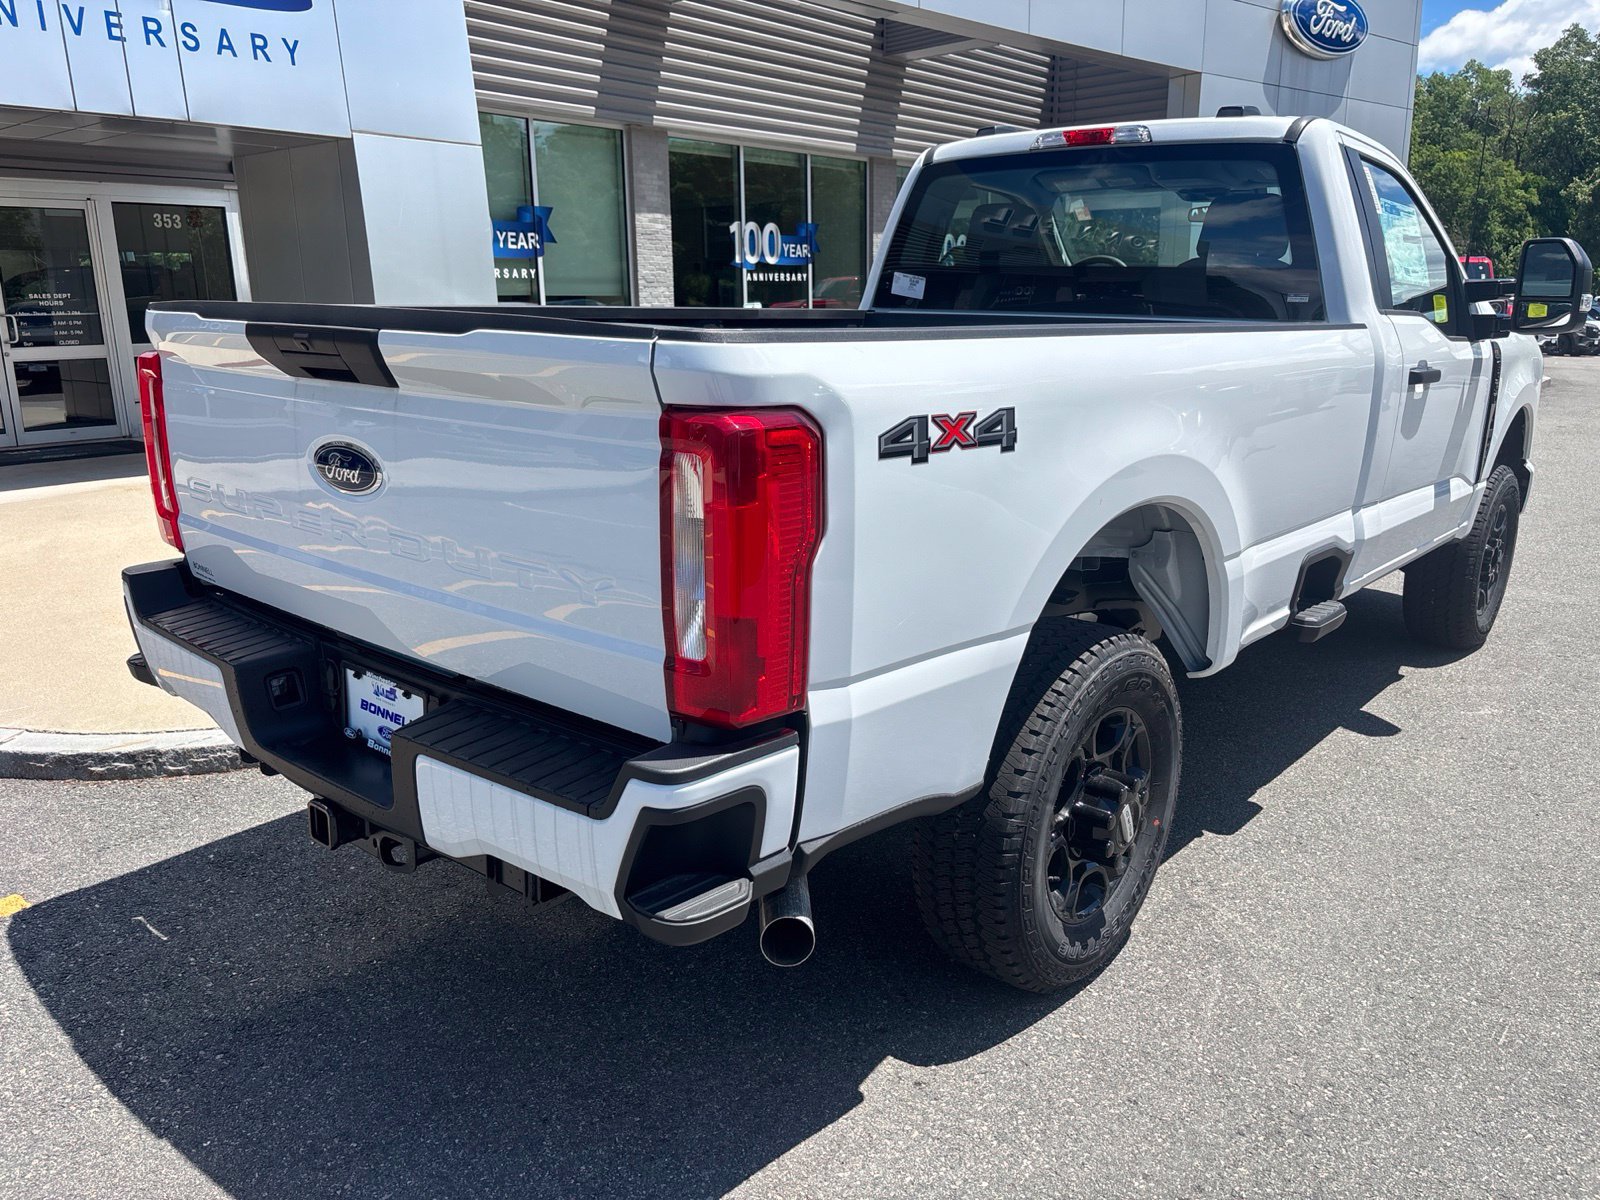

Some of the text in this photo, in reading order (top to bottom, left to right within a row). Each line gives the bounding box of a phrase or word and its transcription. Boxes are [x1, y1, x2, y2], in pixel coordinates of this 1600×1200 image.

[1310, 0, 1357, 43] Ford
[153, 213, 182, 229] 353
[496, 230, 540, 249] YEAR
[729, 221, 811, 265] 100 YEAR
[746, 272, 808, 282] ANNIVERSARY
[325, 452, 362, 484] Ford
[186, 475, 617, 608] SUPER DUTY
[360, 698, 413, 727] BONNEL
